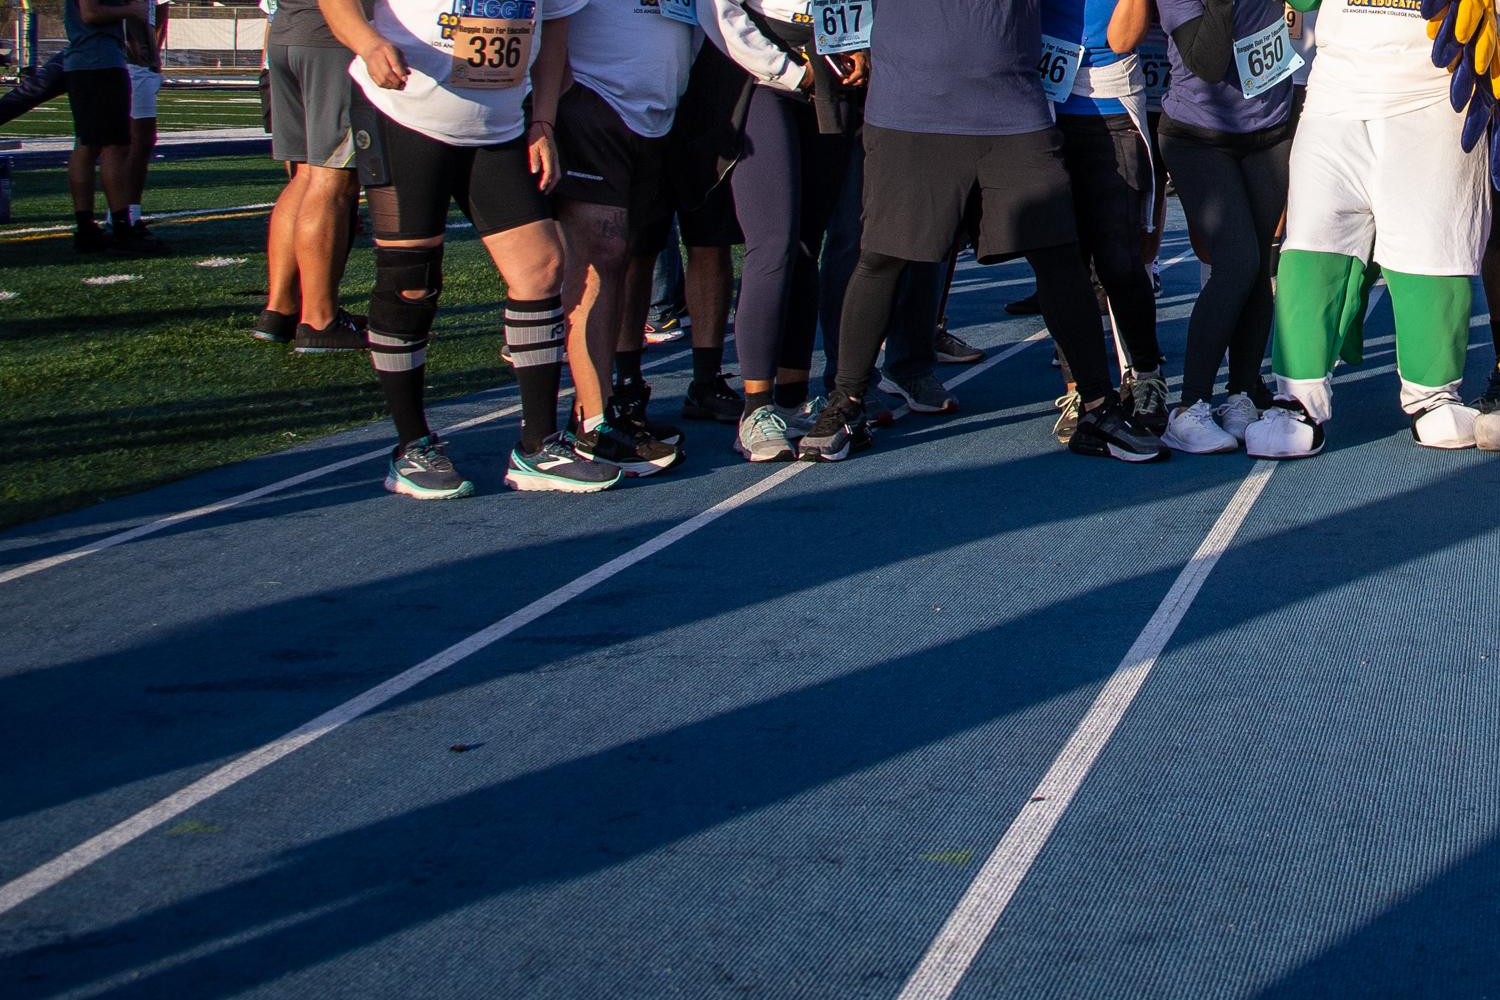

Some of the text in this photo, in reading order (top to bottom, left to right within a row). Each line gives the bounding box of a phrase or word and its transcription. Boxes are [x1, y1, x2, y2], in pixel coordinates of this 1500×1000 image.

[439, 13, 460, 26] 20
[822, 4, 863, 36] 617
[1286, 10, 1296, 28] 9
[467, 35, 521, 68] 336
[1247, 34, 1284, 77] 650
[1037, 52, 1068, 84] 46
[1142, 60, 1172, 88] 67
